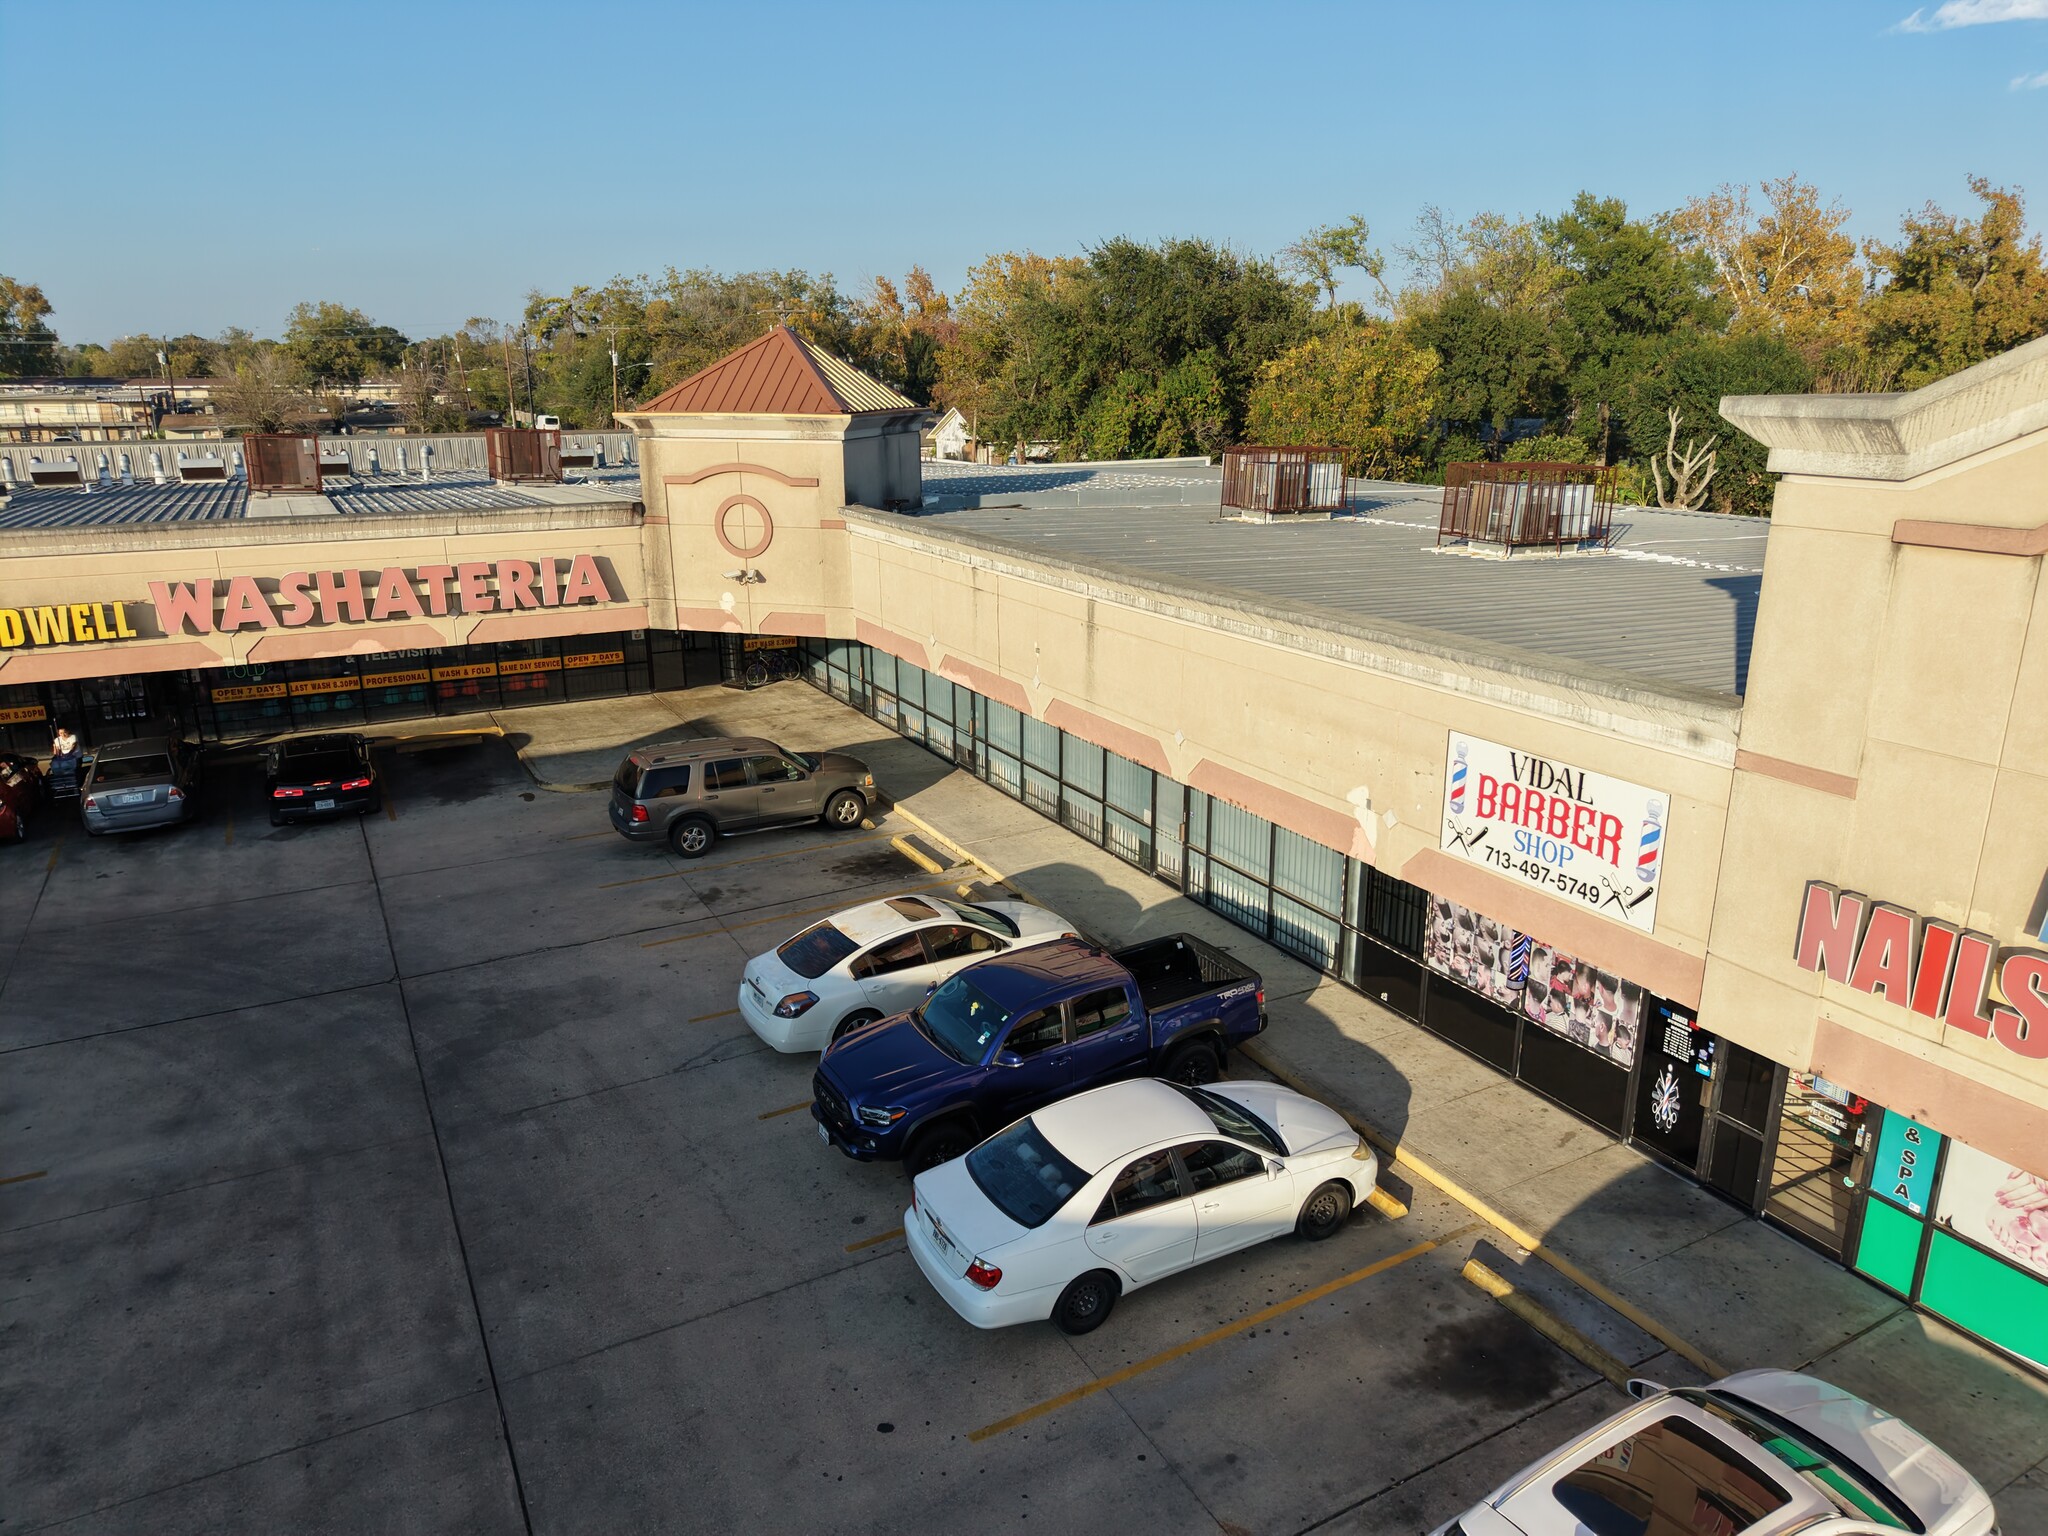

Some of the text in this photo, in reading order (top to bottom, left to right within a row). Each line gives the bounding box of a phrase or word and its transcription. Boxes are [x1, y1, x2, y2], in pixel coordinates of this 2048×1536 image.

[148, 554, 612, 634] WASHATERIA
[500, 664, 519, 672] SAME
[520, 662, 531, 670] DAY
[534, 660, 561, 669] SERVICE
[568, 655, 589, 663] OPEN
[366, 673, 427, 685] PROFESSIONAL
[439, 669, 461, 678] WASH
[471, 667, 491, 675] FOLD
[217, 688, 244, 697] OPEN
[247, 687, 253, 695] 7
[256, 685, 282, 694] DAYS
[290, 679, 359, 693] LAST WASH 8.30PM
[14, 708, 45, 719] 8.30PM
[1509, 751, 1594, 806] VIDAL
[1475, 773, 1625, 868] BARBER
[1513, 829, 1575, 868] SHOP
[1484, 845, 1601, 904] 713-497-5749
[1796, 884, 2048, 1059] NAILS
[1806, 1105, 1848, 1130] WELCOME
[1904, 1127, 1921, 1145] &
[1894, 1150, 1917, 1200] SPA
